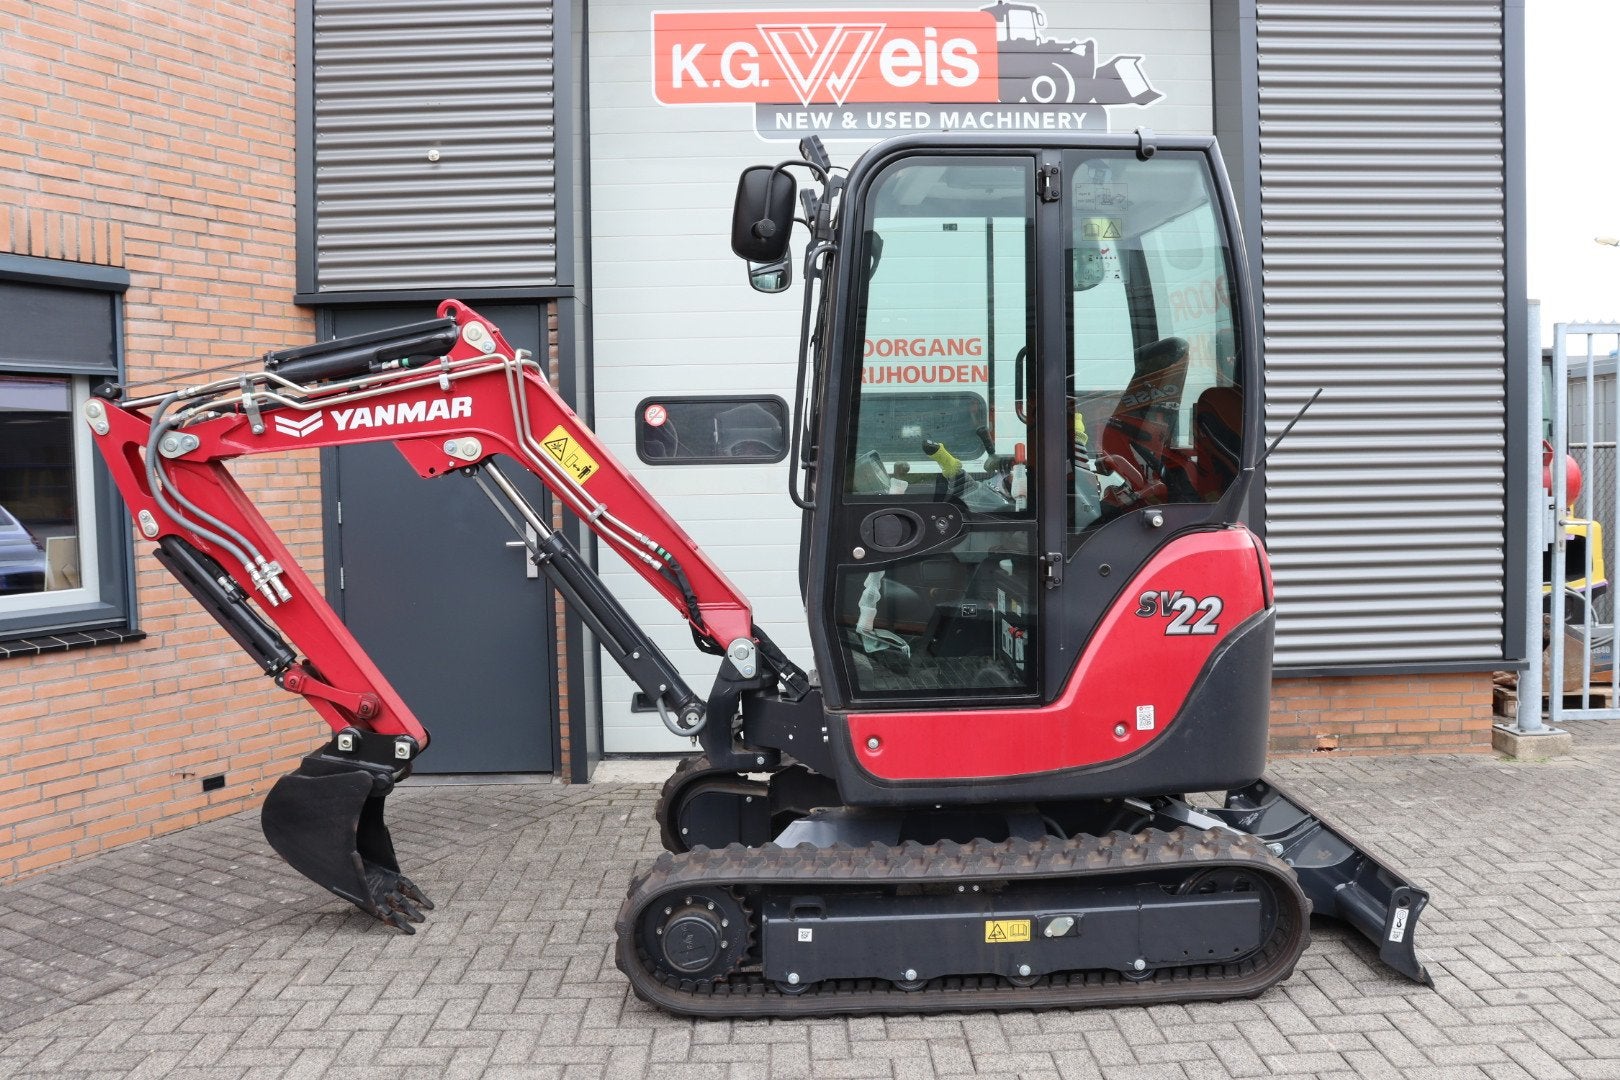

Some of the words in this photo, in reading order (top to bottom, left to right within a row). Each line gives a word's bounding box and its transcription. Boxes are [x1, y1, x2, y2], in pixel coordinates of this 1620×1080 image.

[775, 112, 837, 130] NEW
[841, 112, 858, 130] &
[867, 112, 933, 130] USED
[939, 111, 1087, 131] MACHINERY
[863, 337, 982, 357] OORGANG
[330, 396, 473, 431] YANMAR
